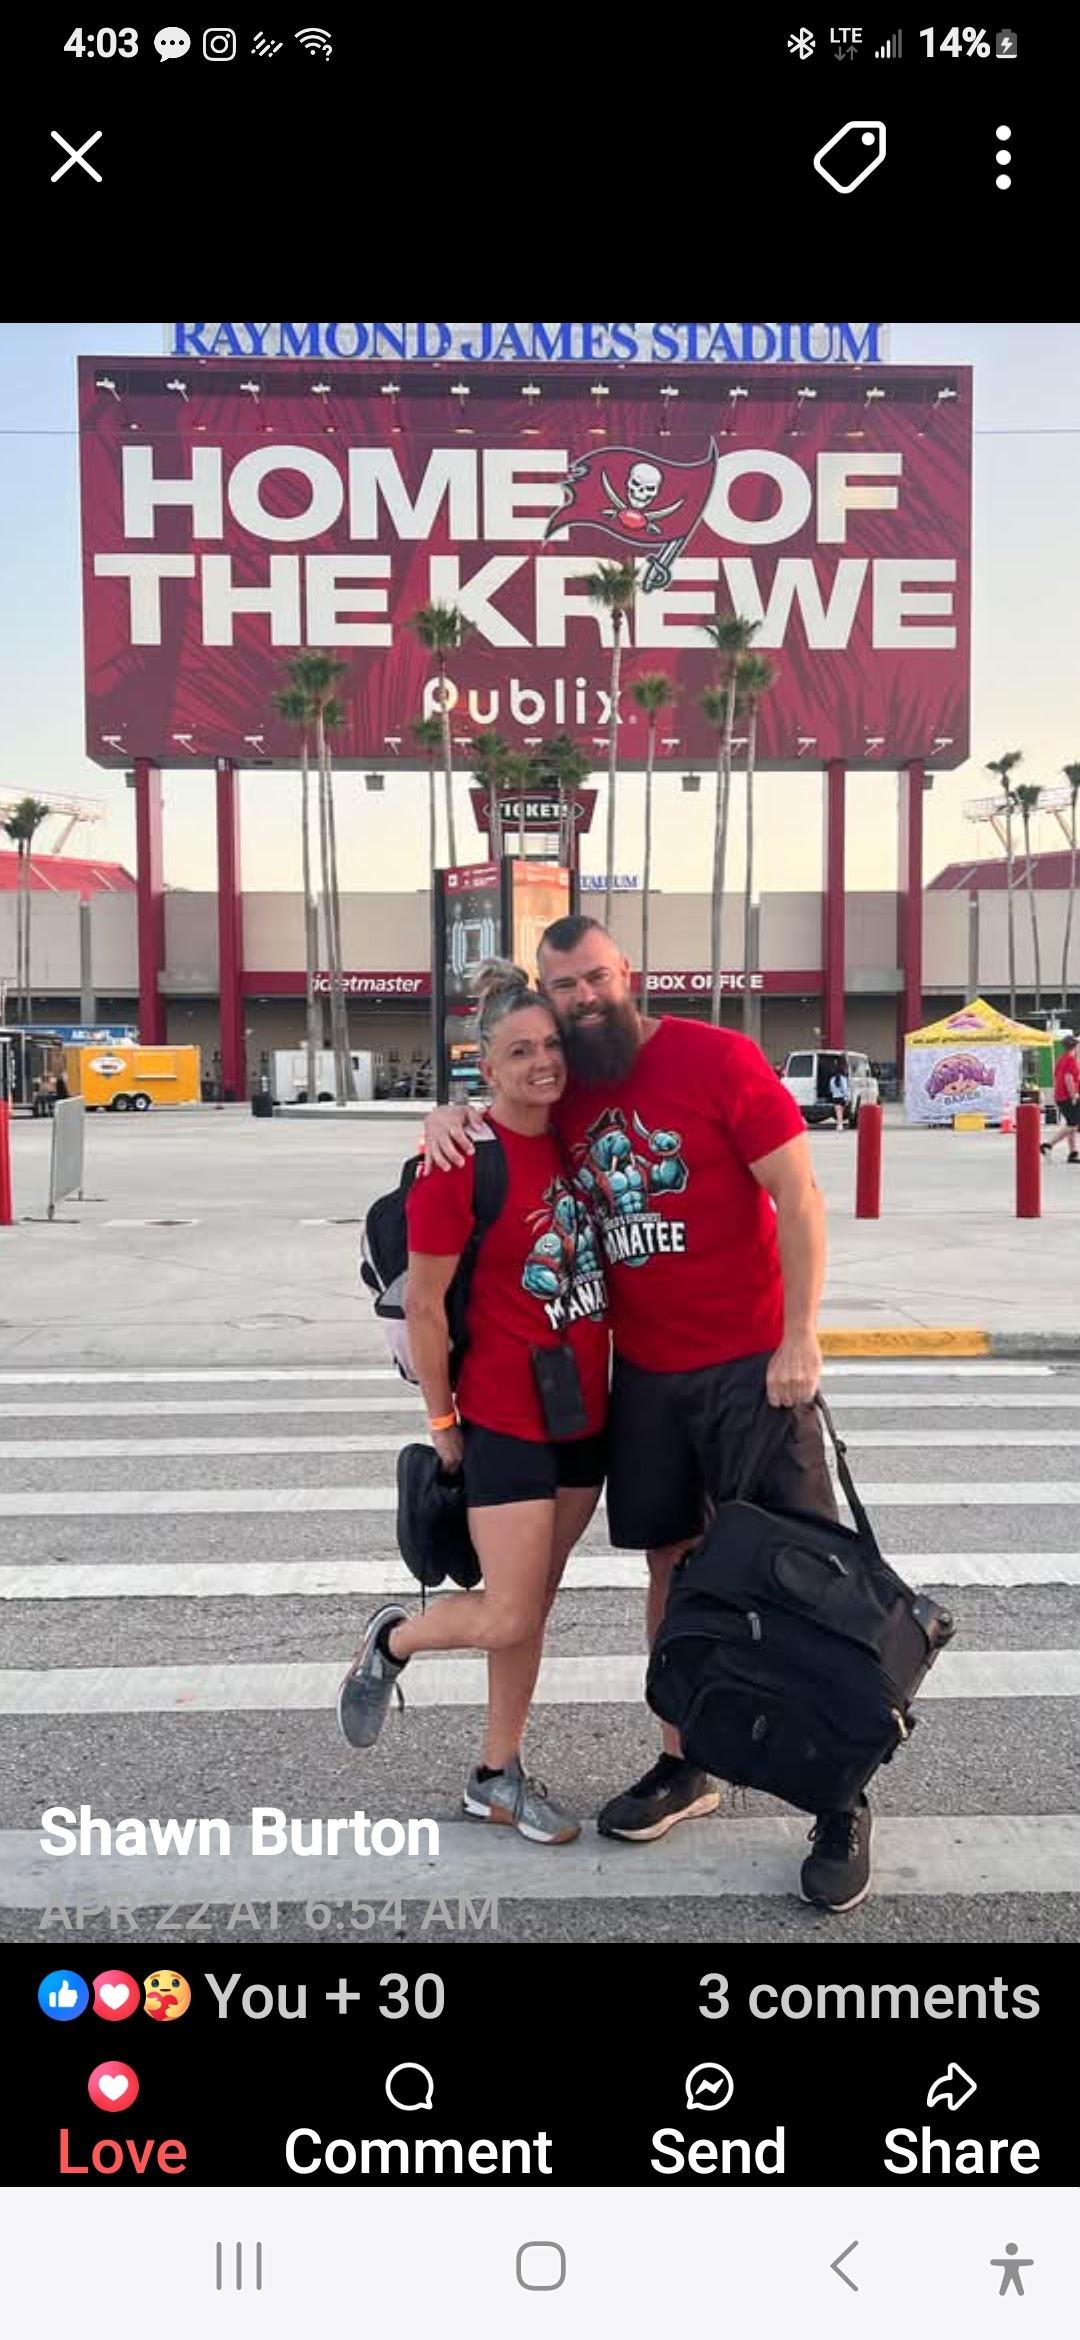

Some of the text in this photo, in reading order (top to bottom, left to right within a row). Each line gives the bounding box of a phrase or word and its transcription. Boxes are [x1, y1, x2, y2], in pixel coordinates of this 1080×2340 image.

[170, 323, 882, 362] RAYMOND JAMES STADIUM
[121, 444, 904, 546] HOME OF
[94, 553, 958, 650] THE KREWE
[423, 676, 624, 725] Publix
[645, 975, 687, 990] BOX
